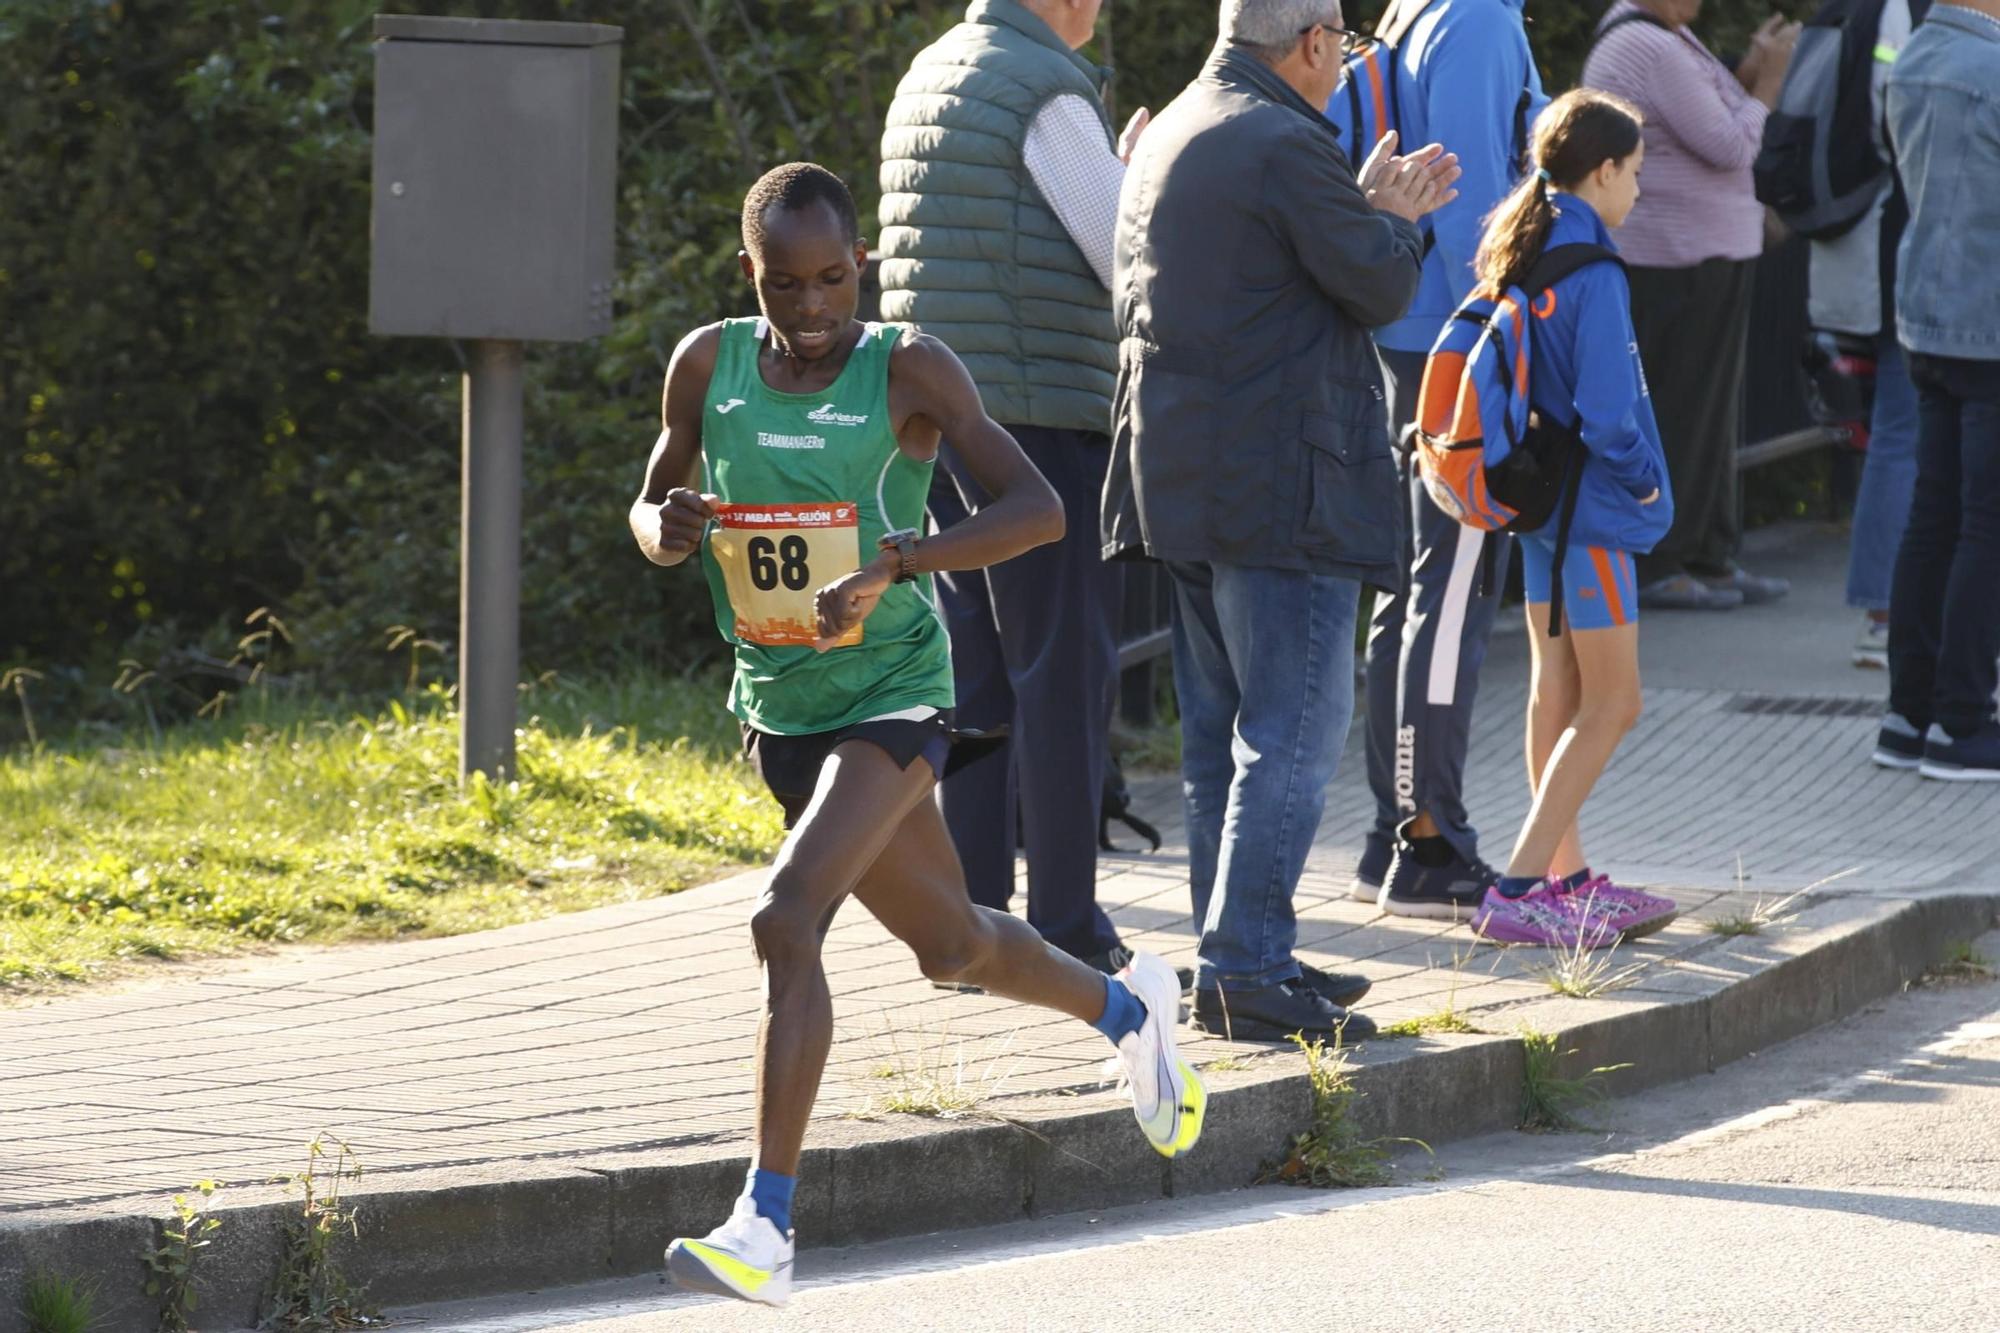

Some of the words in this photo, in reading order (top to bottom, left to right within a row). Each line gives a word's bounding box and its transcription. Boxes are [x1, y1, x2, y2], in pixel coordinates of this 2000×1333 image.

[744, 512, 774, 523] MBA
[798, 510, 831, 522] GIJÓN
[747, 535, 810, 591] 68
